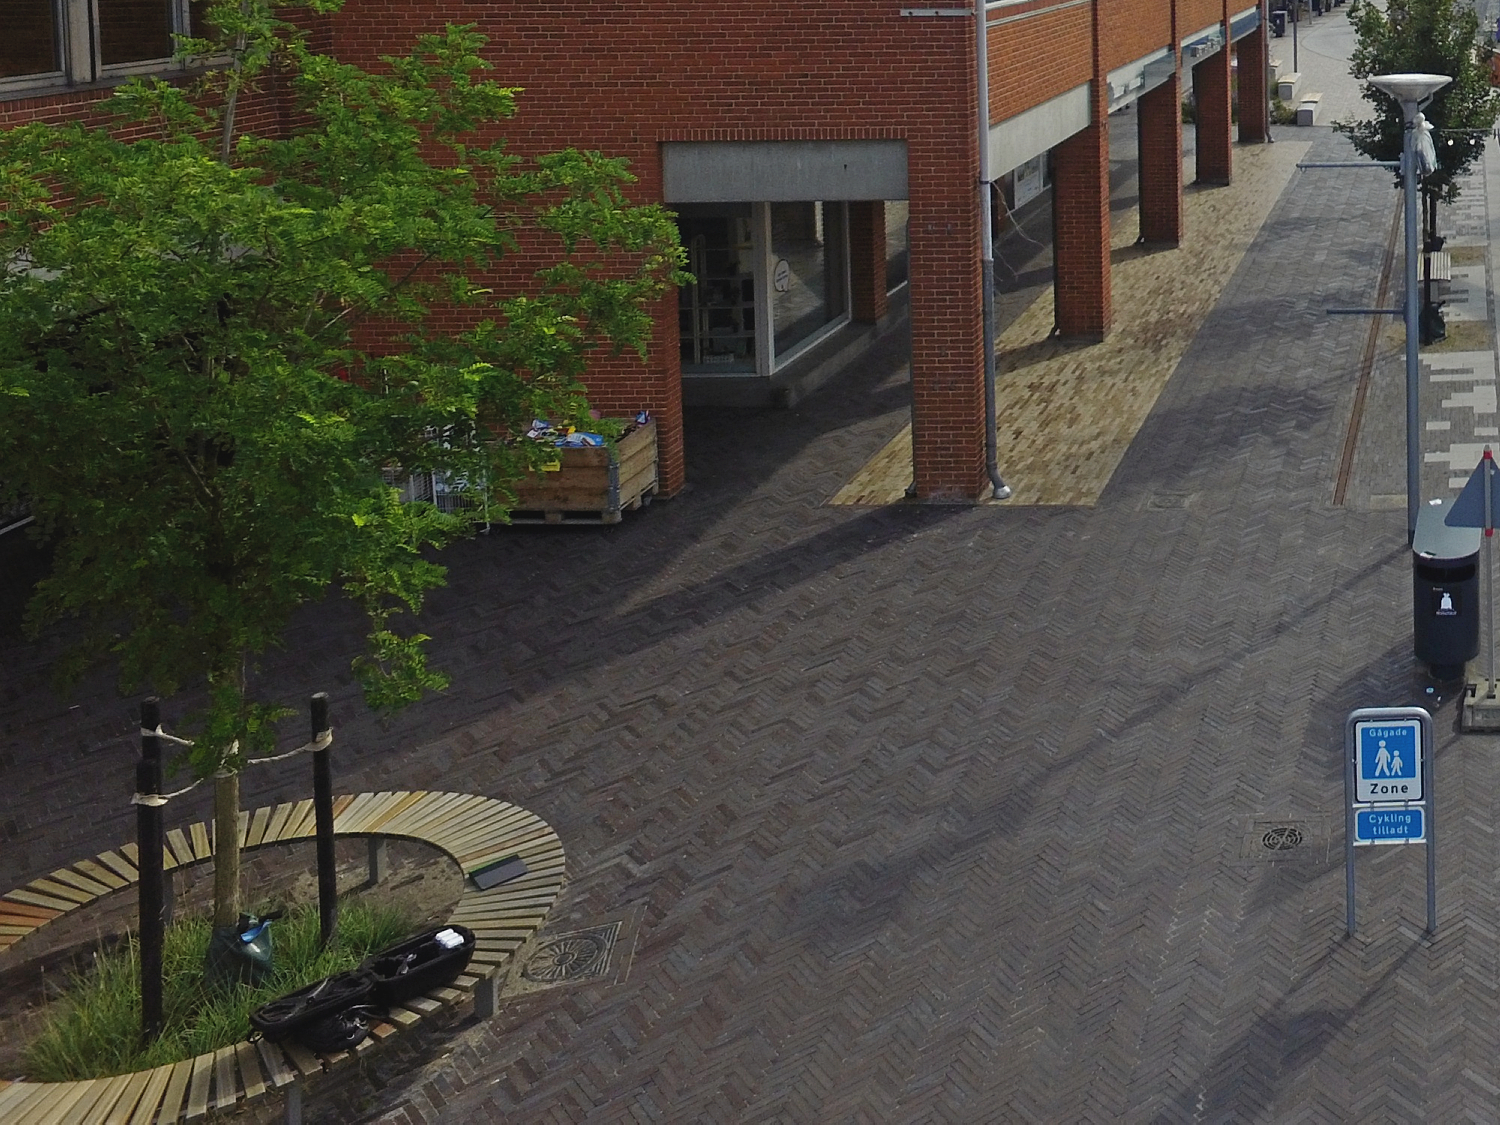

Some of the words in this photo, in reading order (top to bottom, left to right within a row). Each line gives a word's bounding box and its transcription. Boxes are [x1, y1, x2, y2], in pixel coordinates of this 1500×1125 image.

[1369, 728, 1407, 738] Gågade
[1370, 783, 1409, 795] Zone
[1368, 813, 1412, 824] Cykling
[1372, 825, 1409, 835] tilladt
